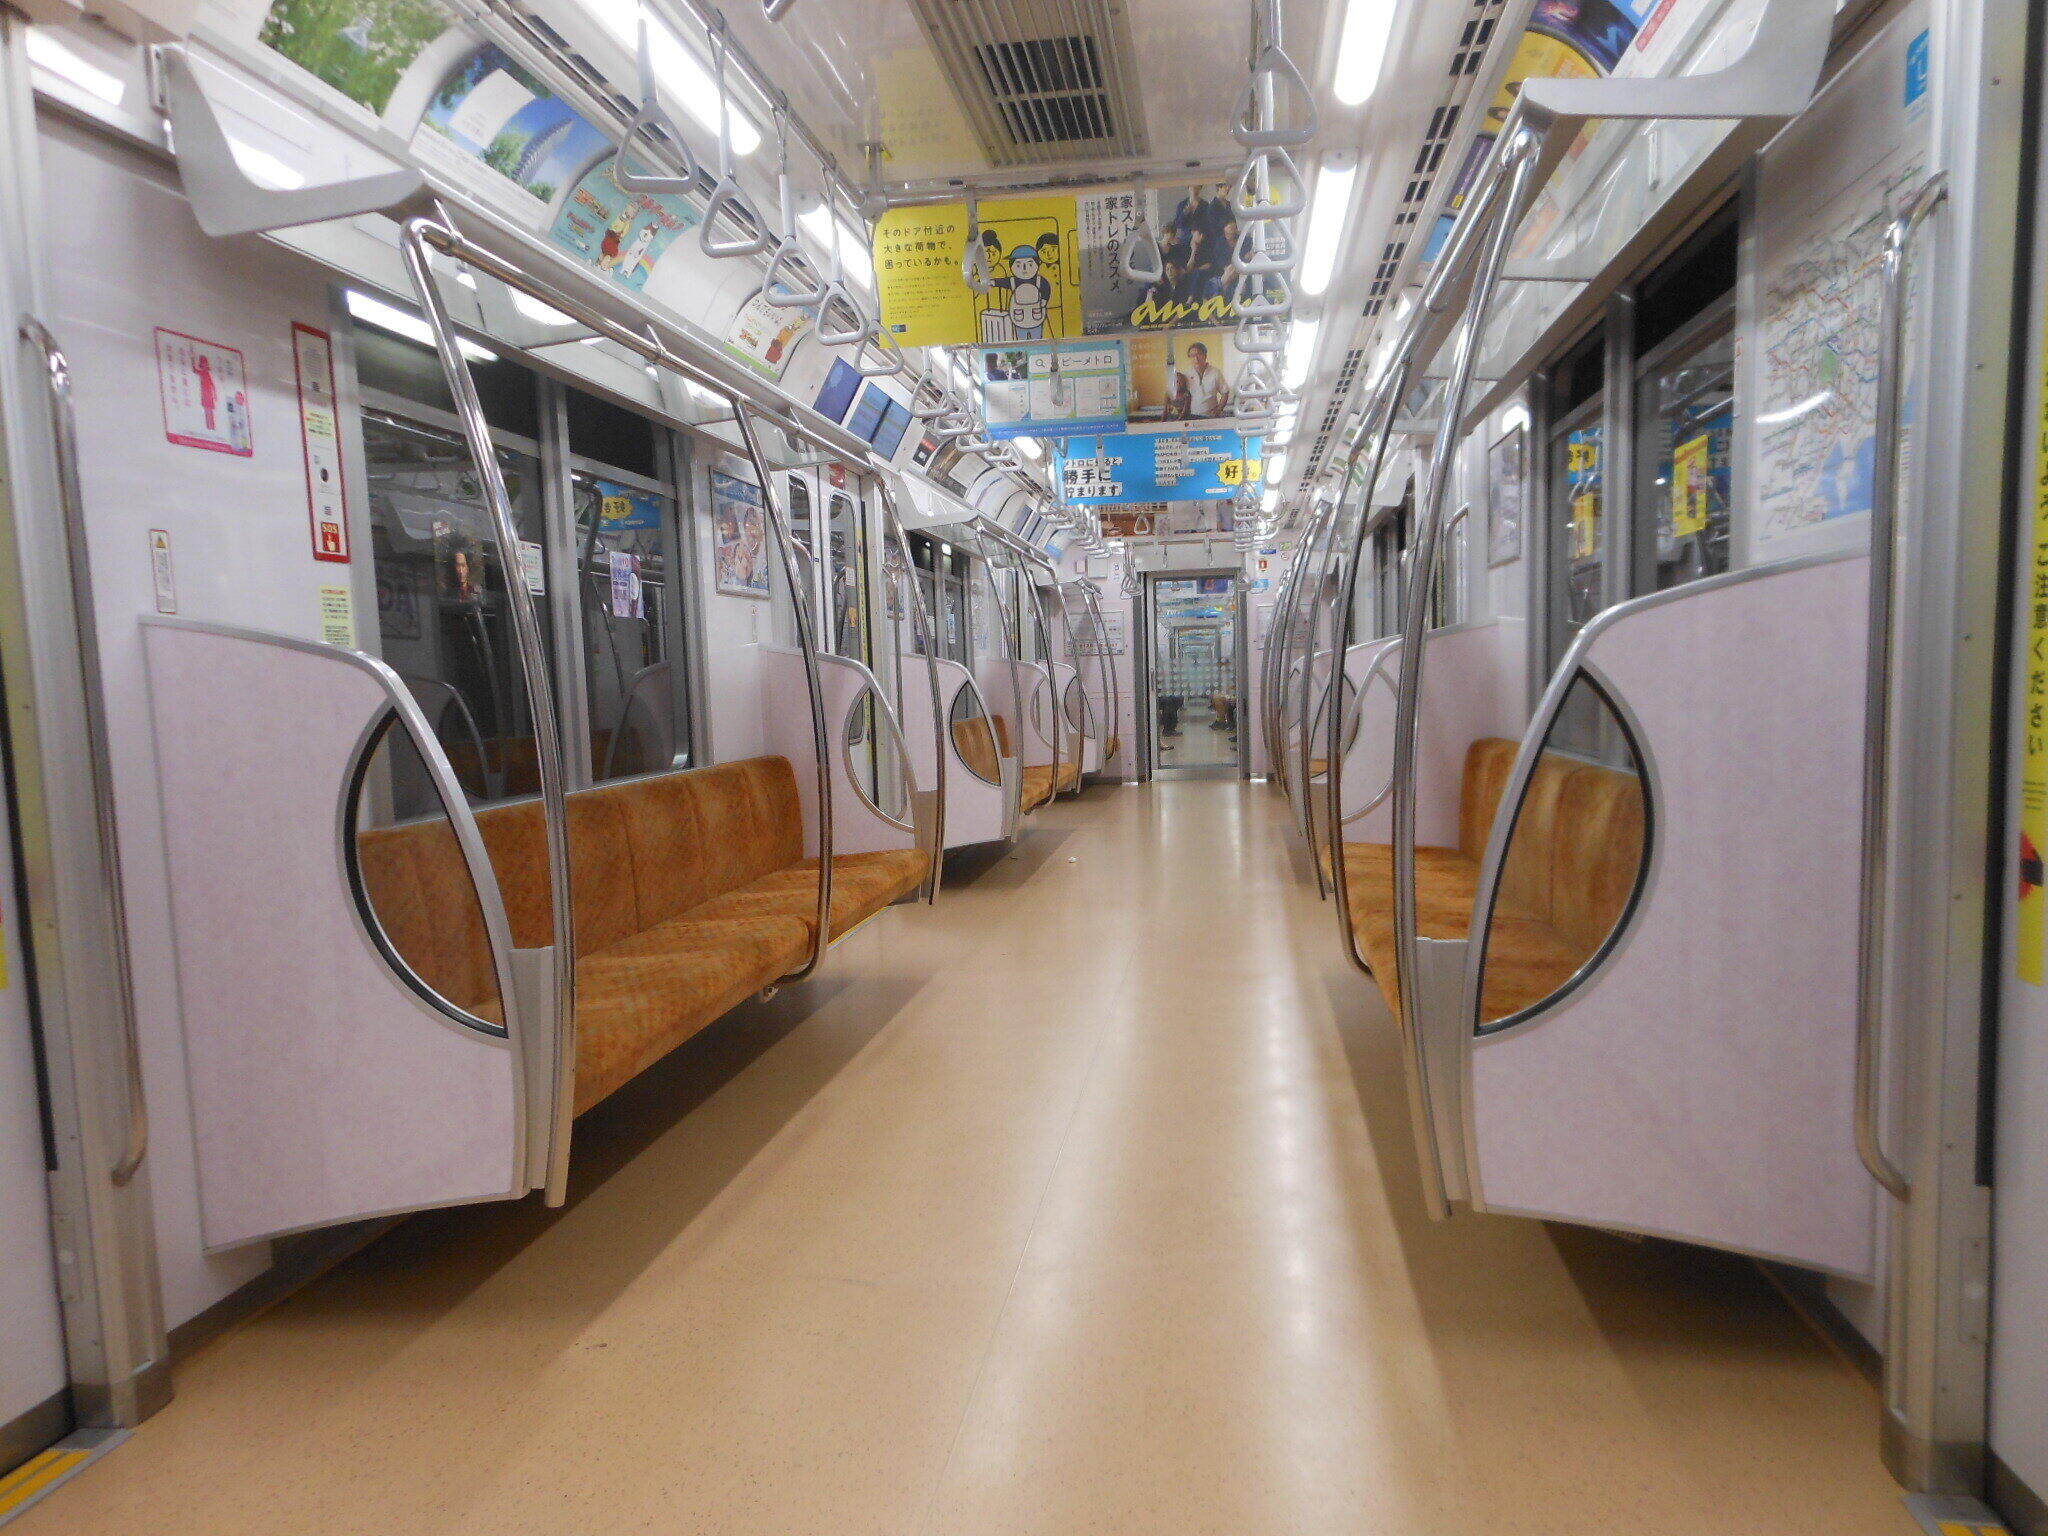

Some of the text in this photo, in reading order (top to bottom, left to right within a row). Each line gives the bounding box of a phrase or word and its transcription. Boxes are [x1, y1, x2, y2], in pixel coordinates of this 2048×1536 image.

[883, 225, 955, 238] そのドア付近の
[884, 241, 953, 254] 大きな荷物で、
[885, 257, 959, 270] 困っているかも。
[1063, 468, 1111, 485] 勝手に
[321, 523, 338, 534] SOS
